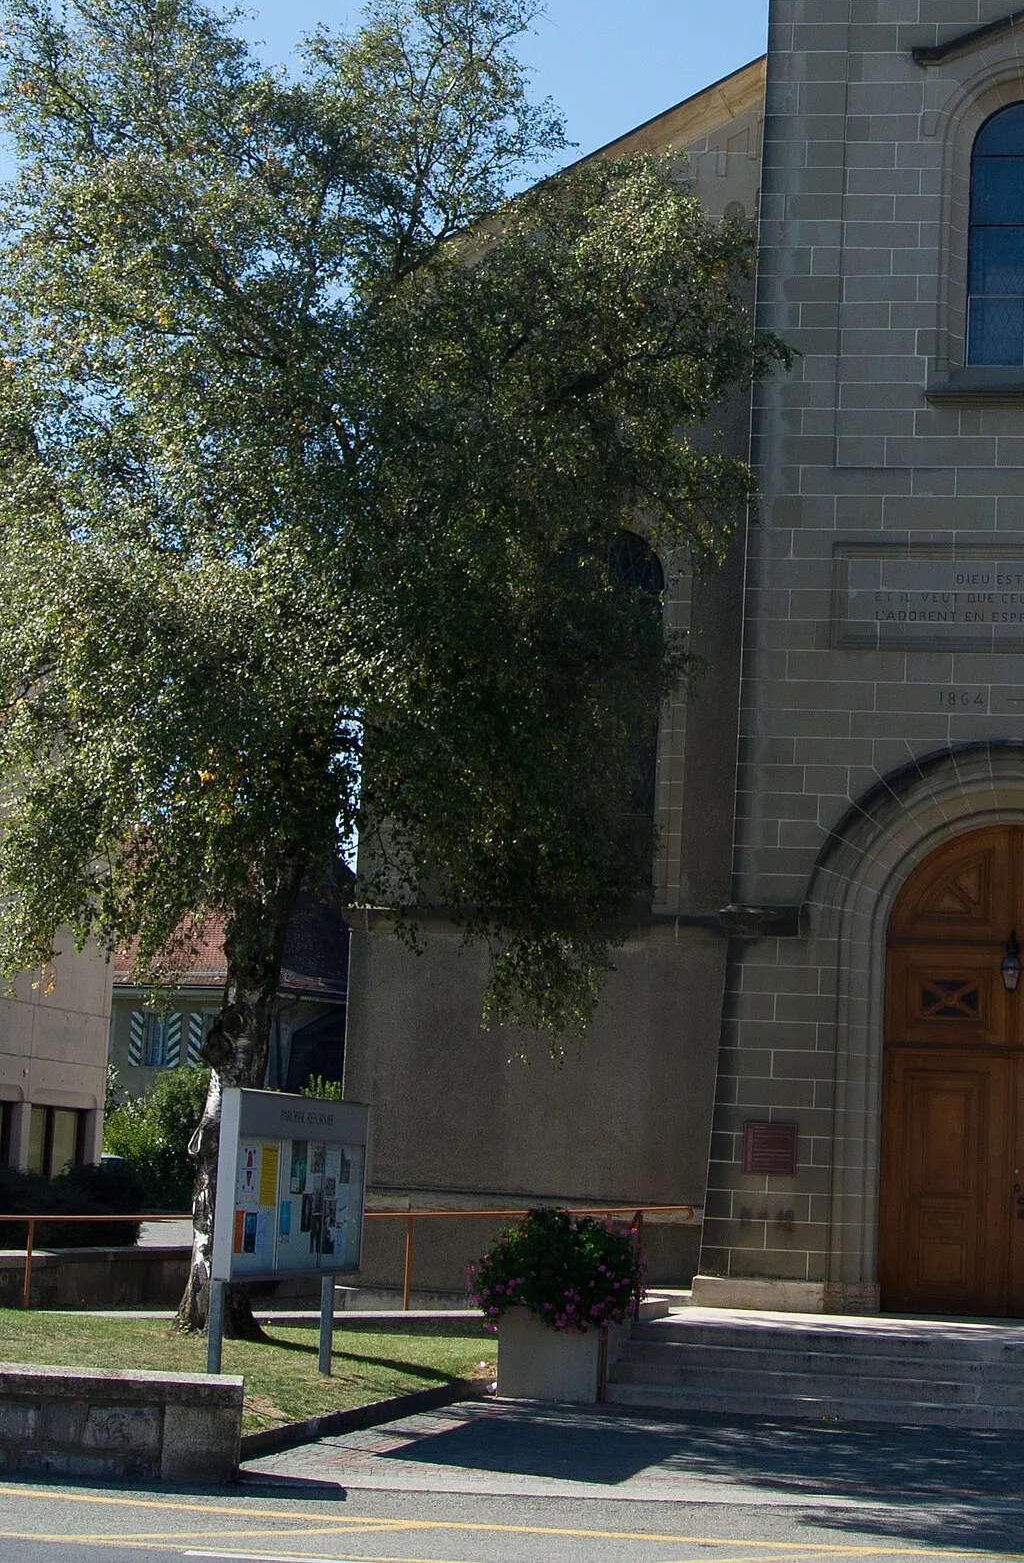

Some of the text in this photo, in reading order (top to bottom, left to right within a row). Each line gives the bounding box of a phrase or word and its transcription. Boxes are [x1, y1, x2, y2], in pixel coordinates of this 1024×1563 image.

[956, 574, 990, 584] DIEU
[996, 575, 1023, 585] EST
[874, 592, 893, 602] ET
[900, 592, 912, 602] IL
[921, 592, 960, 603] VEUT
[967, 593, 995, 604] QUE
[875, 610, 957, 622] L'ADORENT
[965, 612, 985, 622] EN
[939, 691, 985, 706] 1864
